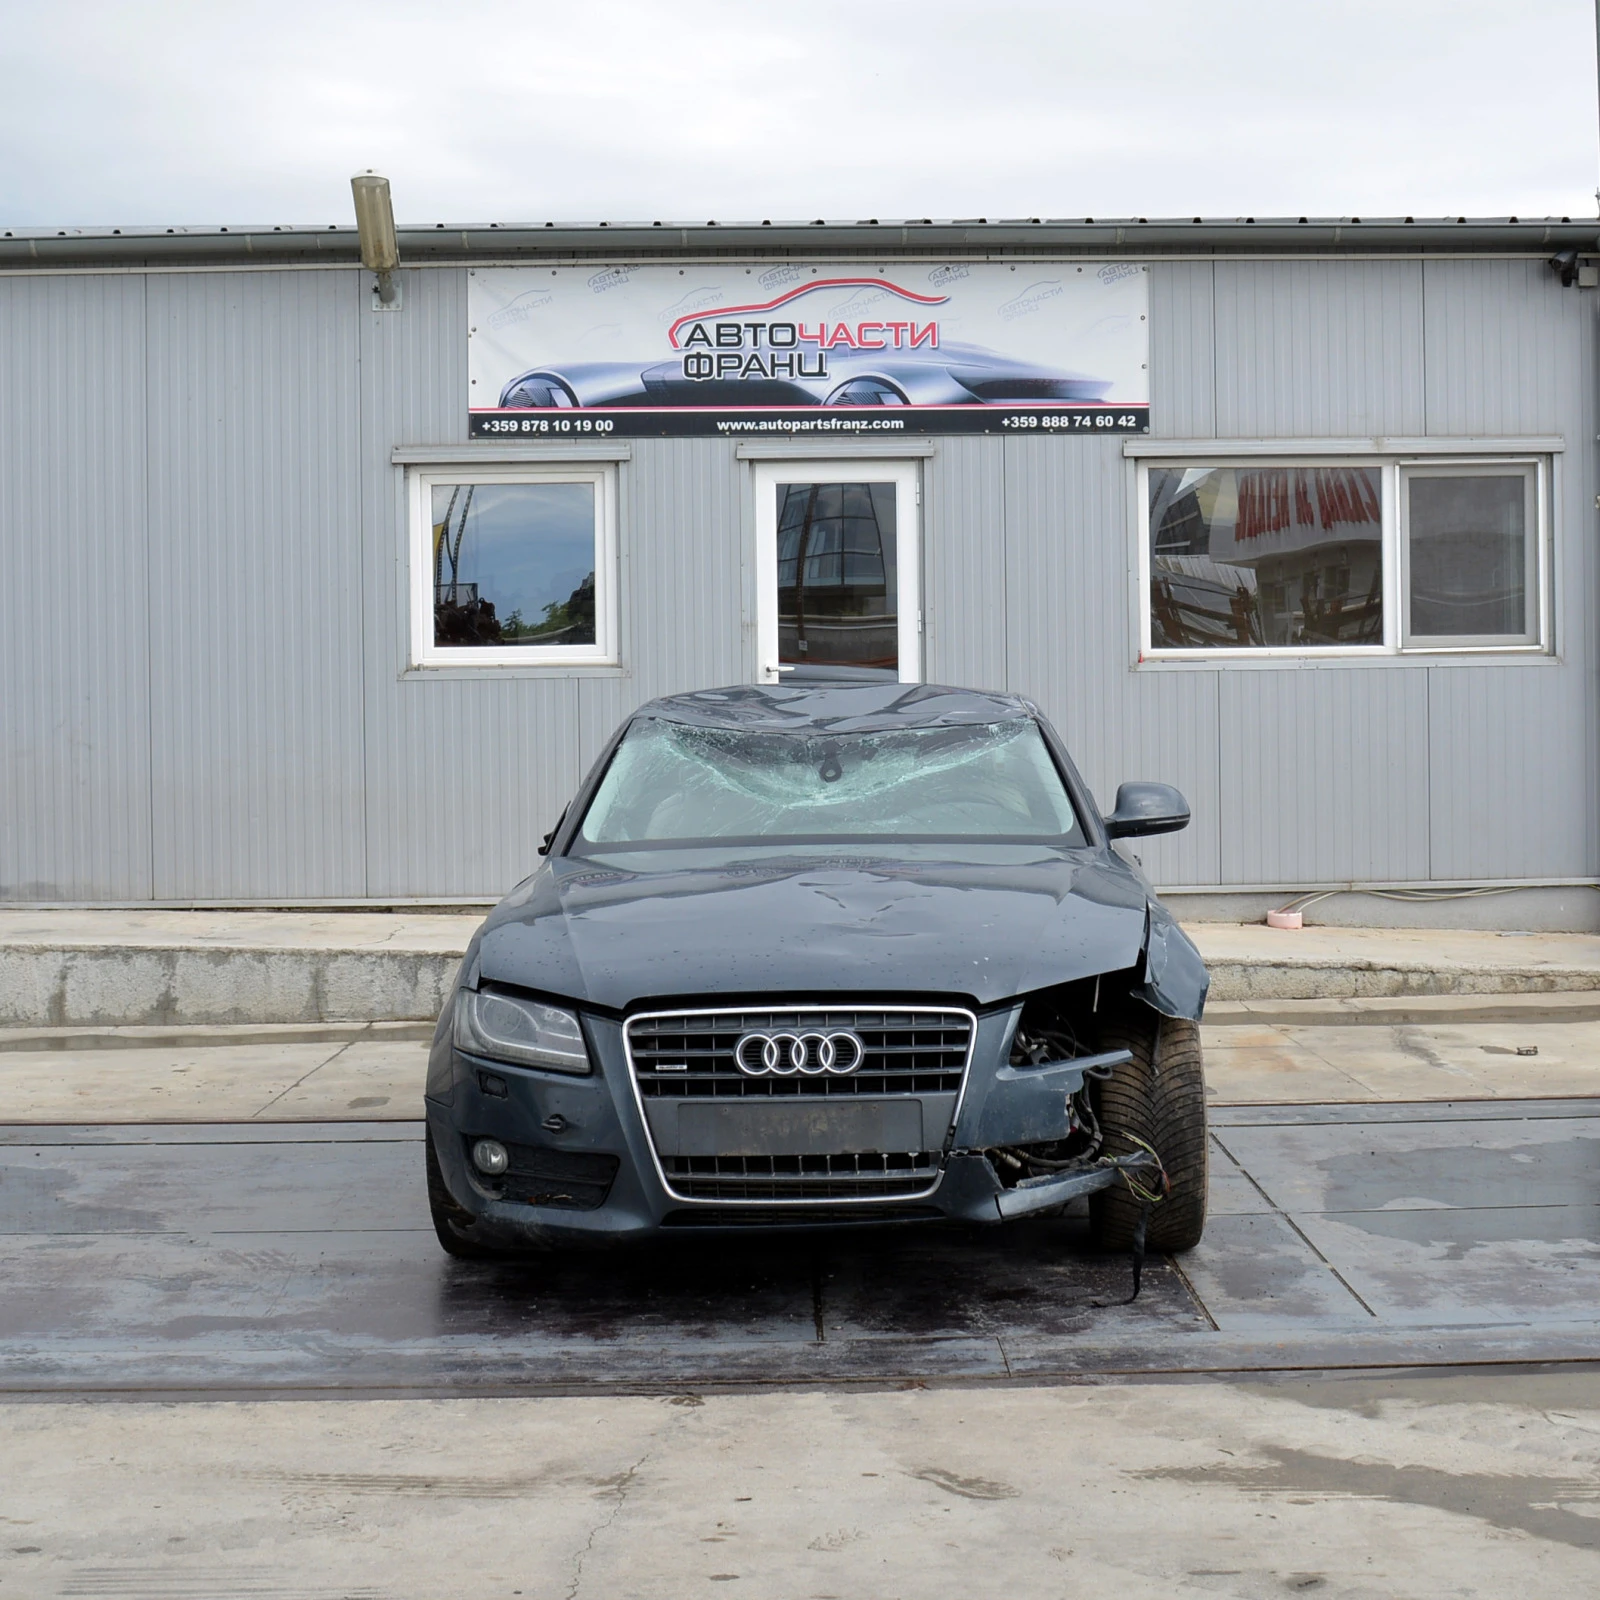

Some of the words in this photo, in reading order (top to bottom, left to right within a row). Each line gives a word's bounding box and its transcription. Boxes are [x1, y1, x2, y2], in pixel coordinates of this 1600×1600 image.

[683, 322, 937, 348] АВТОЧАСТИ
[683, 351, 828, 379] ФРАНЦ
[482, 420, 518, 432] +359
[521, 420, 549, 432] 878
[552, 420, 570, 431] 10
[574, 420, 592, 431] 19
[595, 419, 614, 431] 00
[716, 418, 904, 432] www.autopartsfranz.com
[1002, 416, 1038, 428] +359
[1041, 416, 1069, 427] 888
[1073, 416, 1091, 427] 74
[1096, 416, 1114, 427] 60
[1117, 415, 1136, 427] 42
